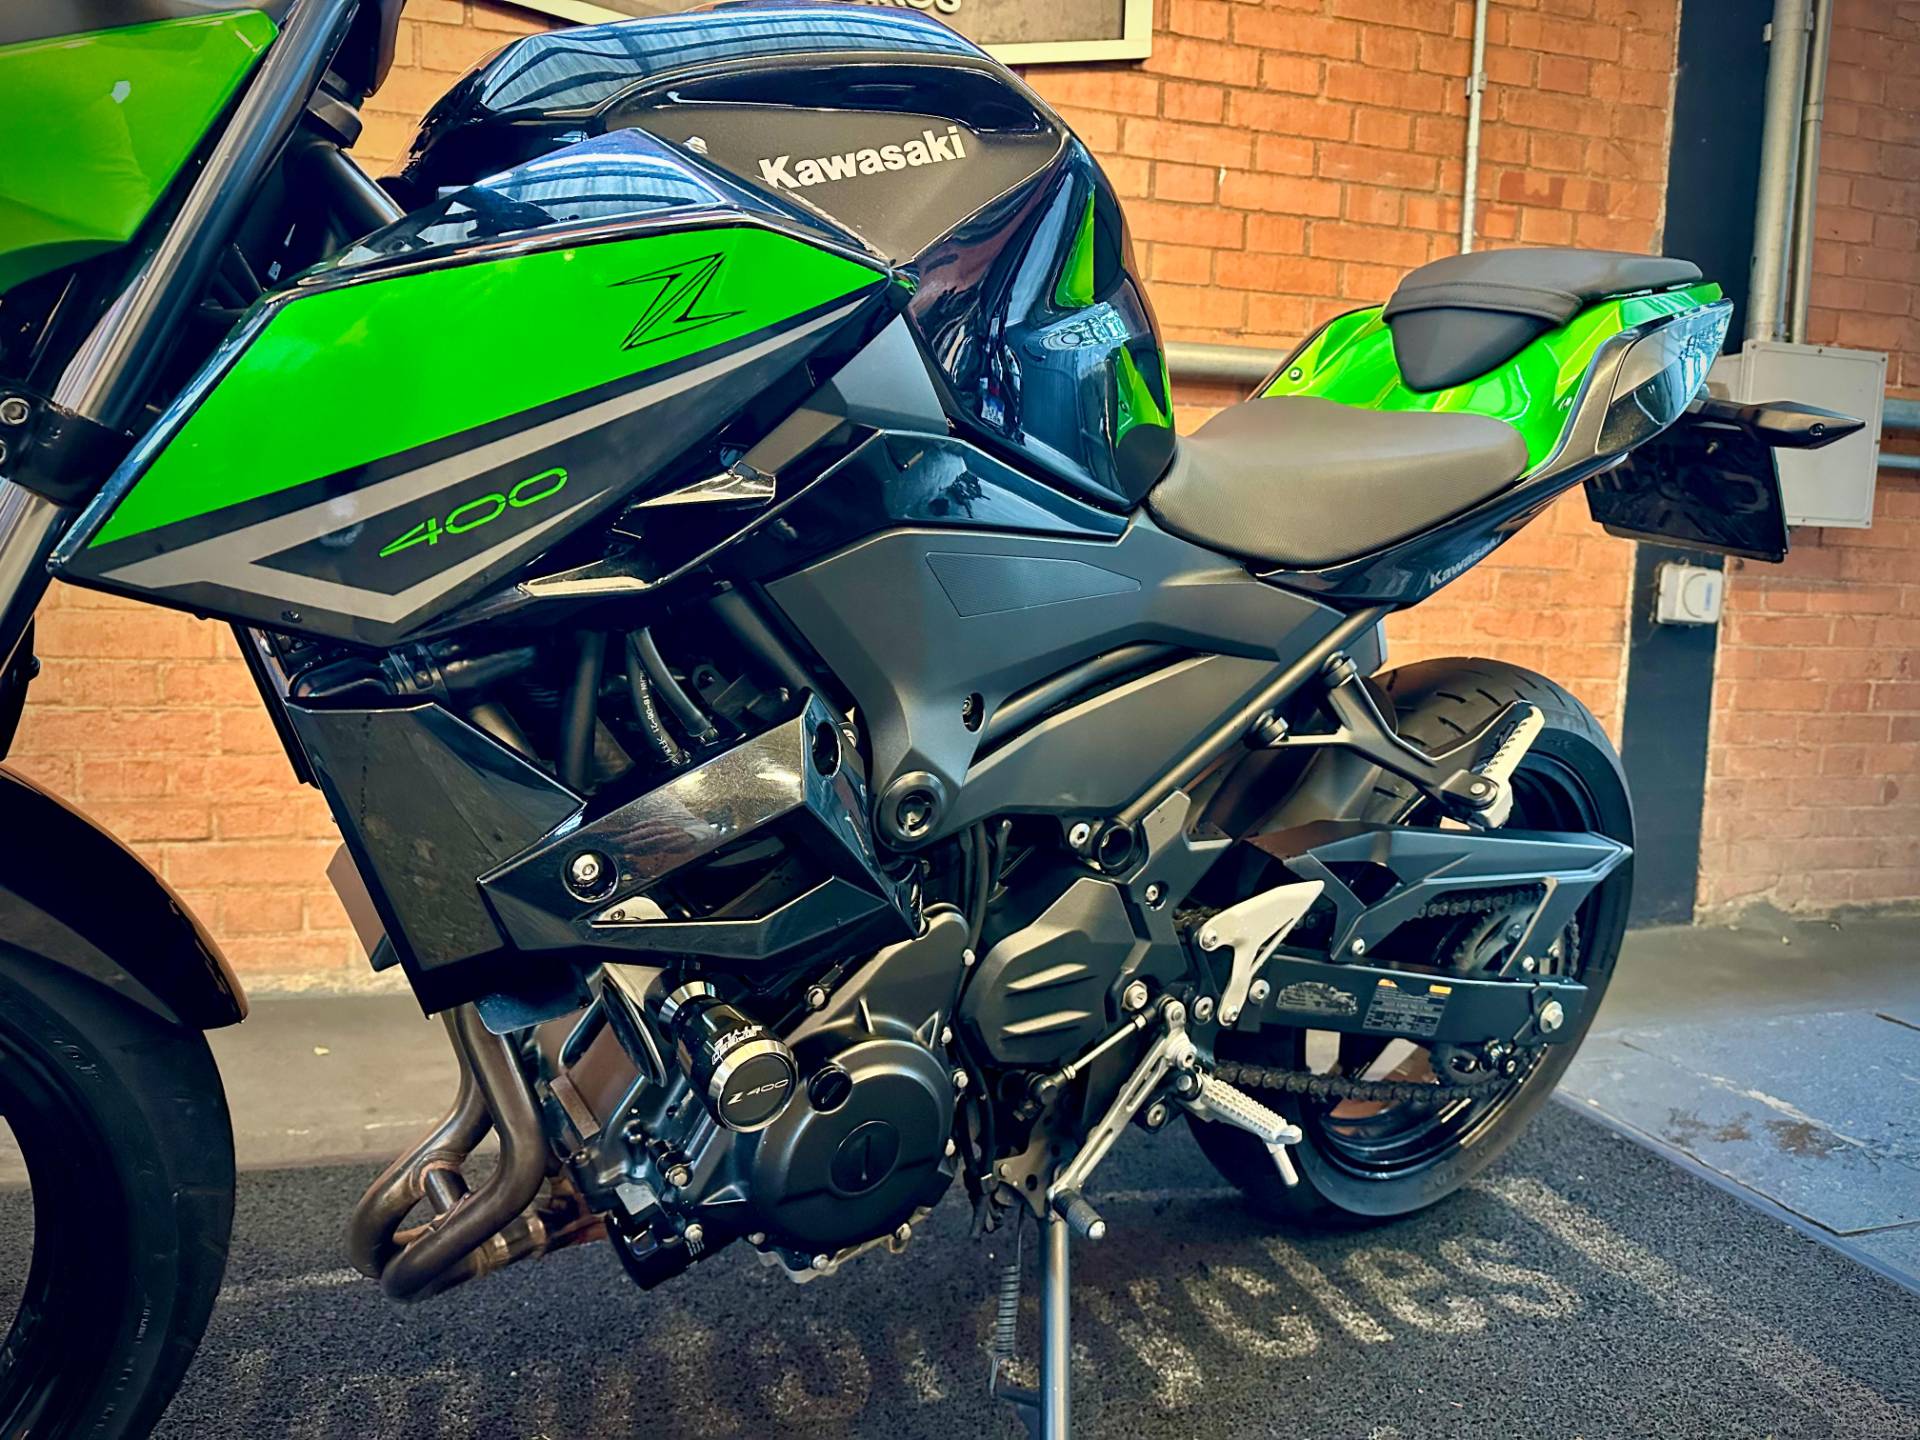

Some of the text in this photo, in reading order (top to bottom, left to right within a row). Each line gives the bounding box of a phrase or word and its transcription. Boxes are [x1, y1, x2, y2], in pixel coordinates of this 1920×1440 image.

[757, 125, 967, 190] Kawasaki
[606, 251, 748, 352] Z
[378, 466, 569, 558] 400
[1429, 531, 1504, 589] Kawasaki
[727, 1078, 790, 1105] Z 400
